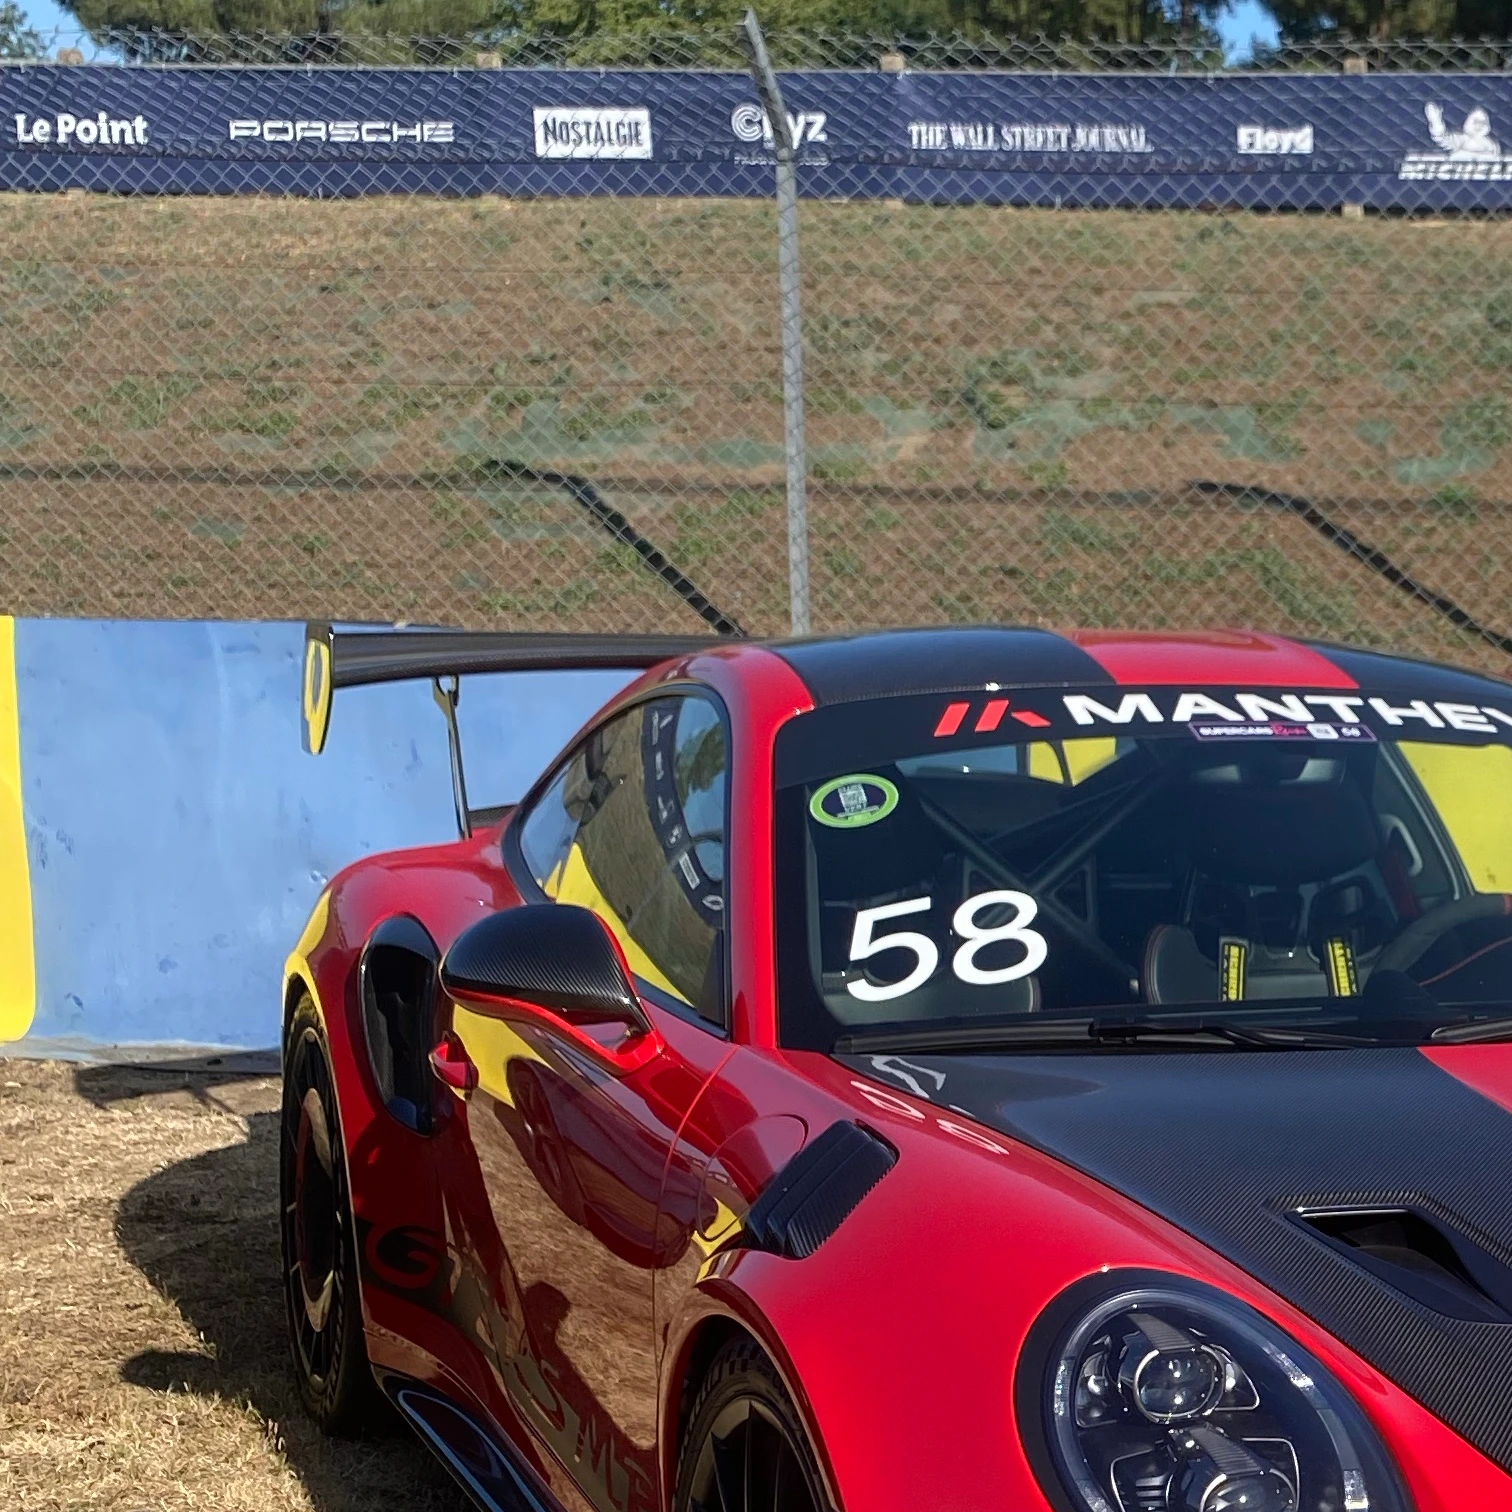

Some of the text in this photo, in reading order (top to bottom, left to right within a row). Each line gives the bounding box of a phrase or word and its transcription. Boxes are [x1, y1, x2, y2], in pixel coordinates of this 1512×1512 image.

[14, 110, 149, 145] Le Point
[228, 118, 455, 144] PORSCHE
[542, 117, 644, 150] NOSTALGIE
[907, 120, 948, 150] THE
[949, 120, 999, 151] WALL
[1000, 121, 1071, 152] STREET
[1236, 124, 1314, 154] Floyd
[845, 889, 1049, 1002] 58
